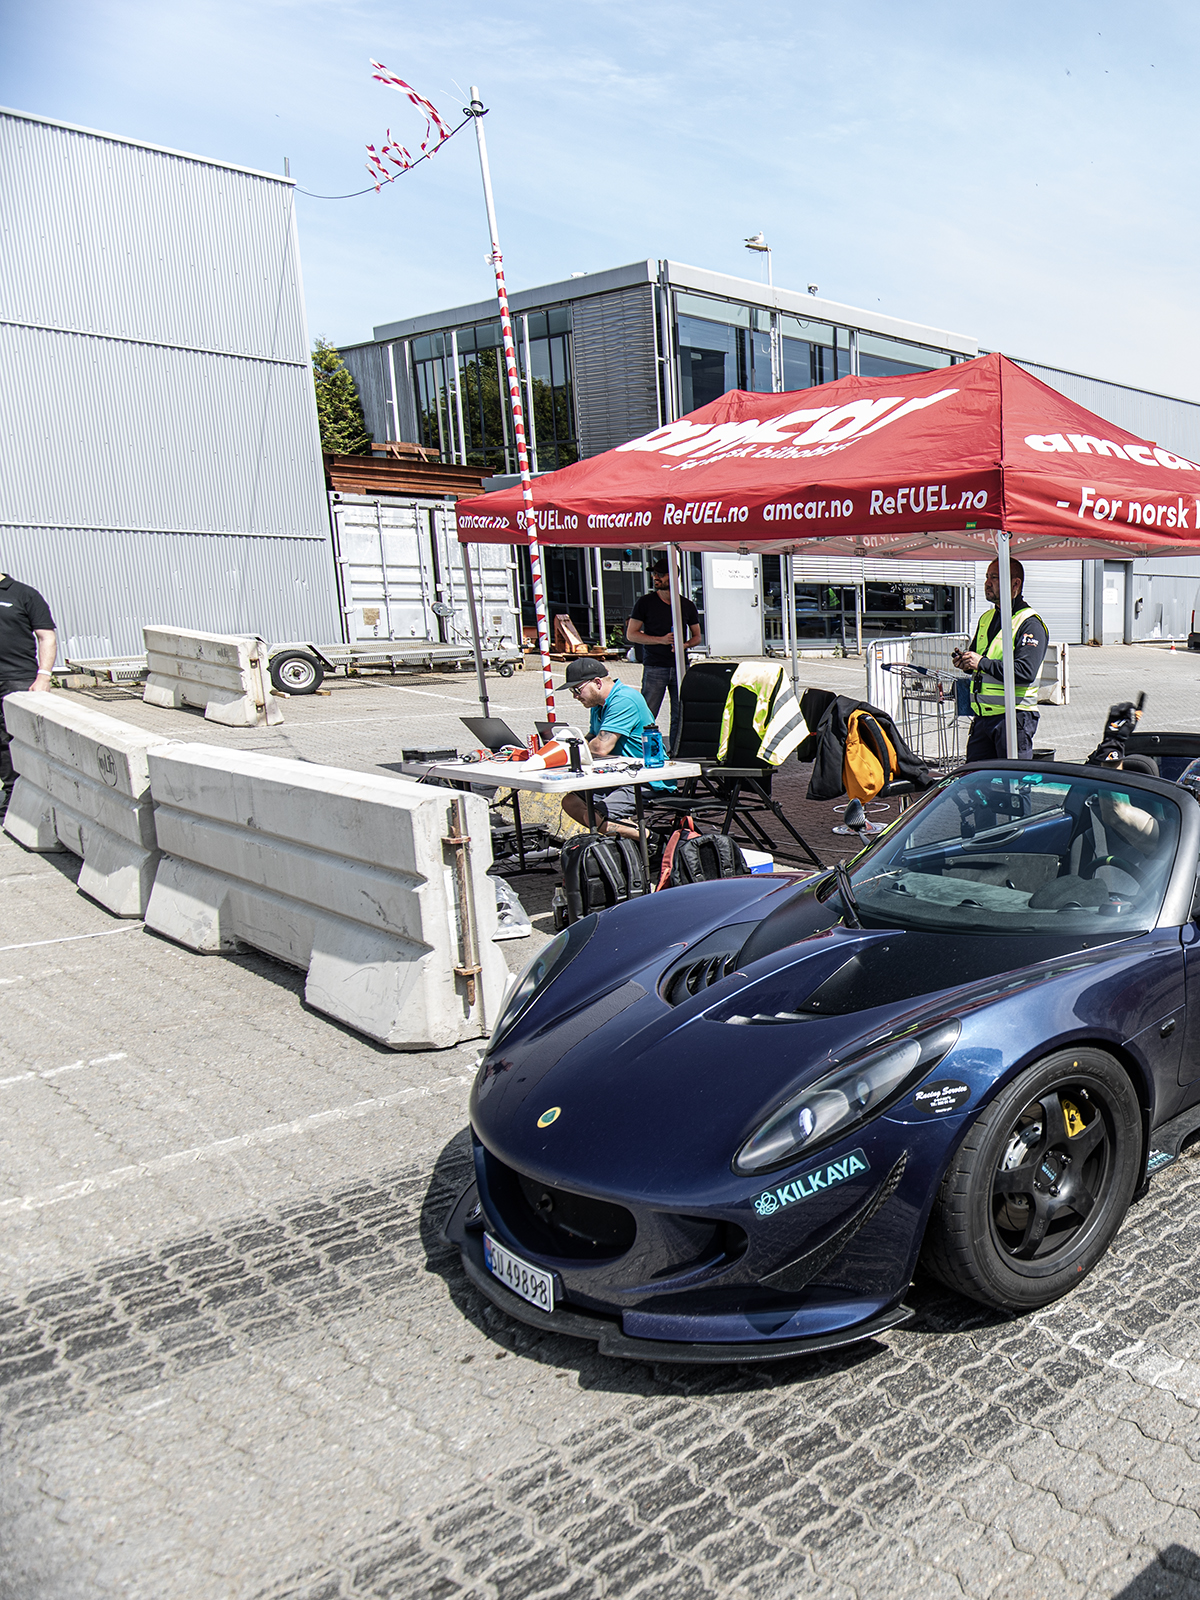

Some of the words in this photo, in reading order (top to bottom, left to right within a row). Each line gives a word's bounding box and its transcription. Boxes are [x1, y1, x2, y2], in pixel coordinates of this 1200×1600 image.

[458, 515, 510, 529] amcar.no
[587, 510, 652, 529] amcar.no
[663, 501, 749, 526] ReFUEL.no
[762, 499, 854, 521] amcar.no
[869, 485, 988, 516] ReFUEL.no
[1077, 486, 1123, 521] For
[1127, 497, 1190, 529] norsk
[915, 1090, 941, 1101] Racing
[942, 1085, 968, 1096] Service
[776, 1155, 866, 1206] KILKAYA
[506, 1260, 547, 1304] 49898
